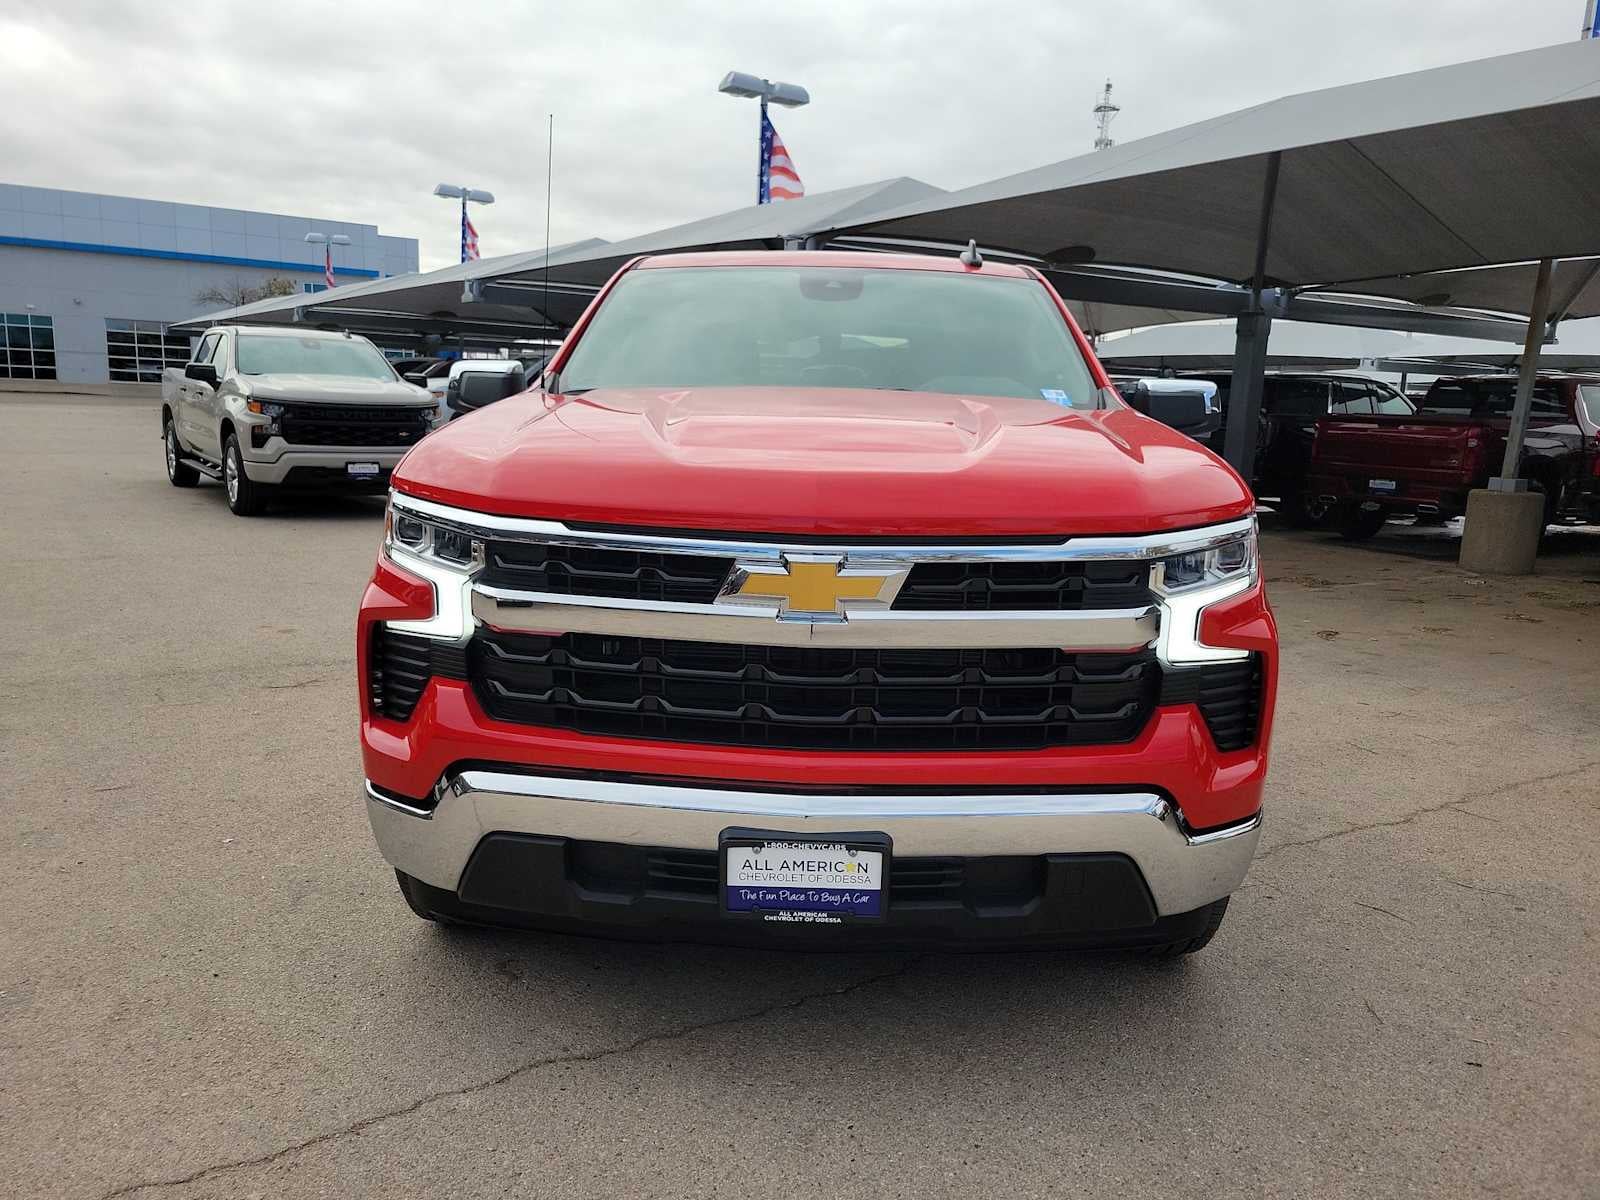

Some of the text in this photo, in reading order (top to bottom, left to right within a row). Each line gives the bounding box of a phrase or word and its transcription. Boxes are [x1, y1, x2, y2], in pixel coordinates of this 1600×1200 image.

[742, 859, 869, 873] ALL AMERICN
[738, 872, 872, 884] CHEVROLET OF ODESSA
[739, 889, 871, 906] The Fun Place To Buy A Car
[763, 914, 804, 922] CHEVROLET
